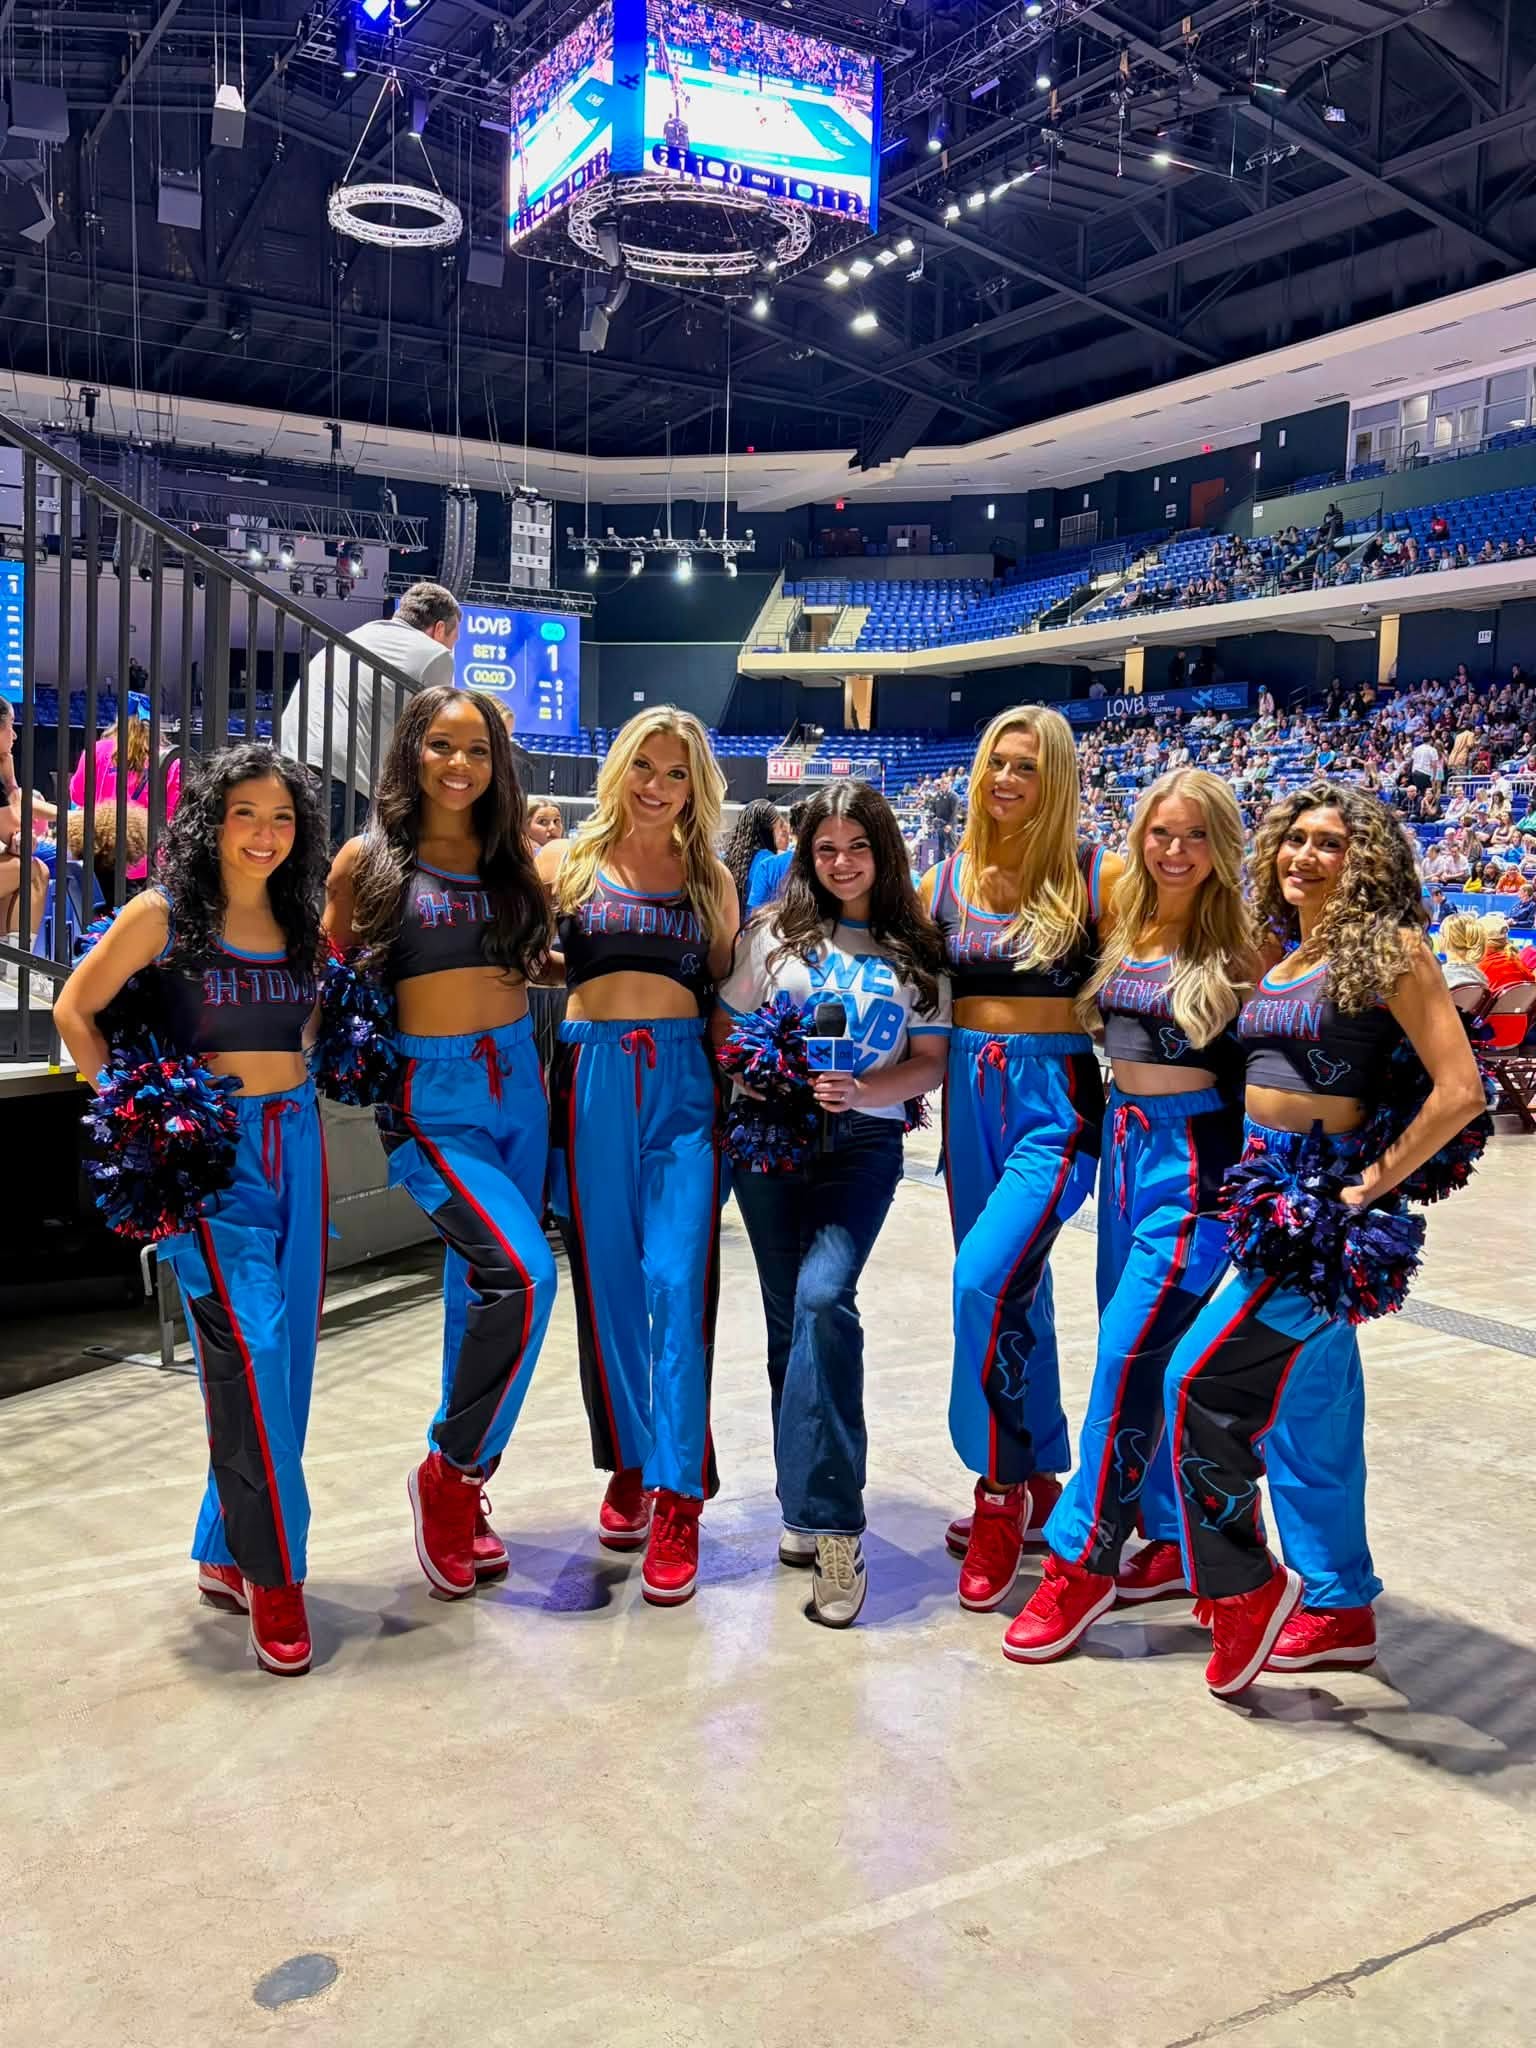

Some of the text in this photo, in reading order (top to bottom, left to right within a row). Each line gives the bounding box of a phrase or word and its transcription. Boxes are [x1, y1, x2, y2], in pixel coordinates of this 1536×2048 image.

[659, 152, 669, 167] 2
[679, 157, 686, 171] 1
[697, 161, 703, 176] 1
[729, 163, 742, 185] 0
[783, 177, 791, 197] 1
[467, 615, 511, 635] LOVB
[473, 643, 497, 659] SET
[547, 644, 559, 672] 1
[555, 679, 564, 692] 2
[556, 693, 563, 706] 1
[1106, 695, 1144, 718] LOVB
[556, 708, 563, 720] 1
[769, 762, 800, 777] EXIT
[833, 762, 849, 771] EXIT
[807, 950, 896, 998] WE
